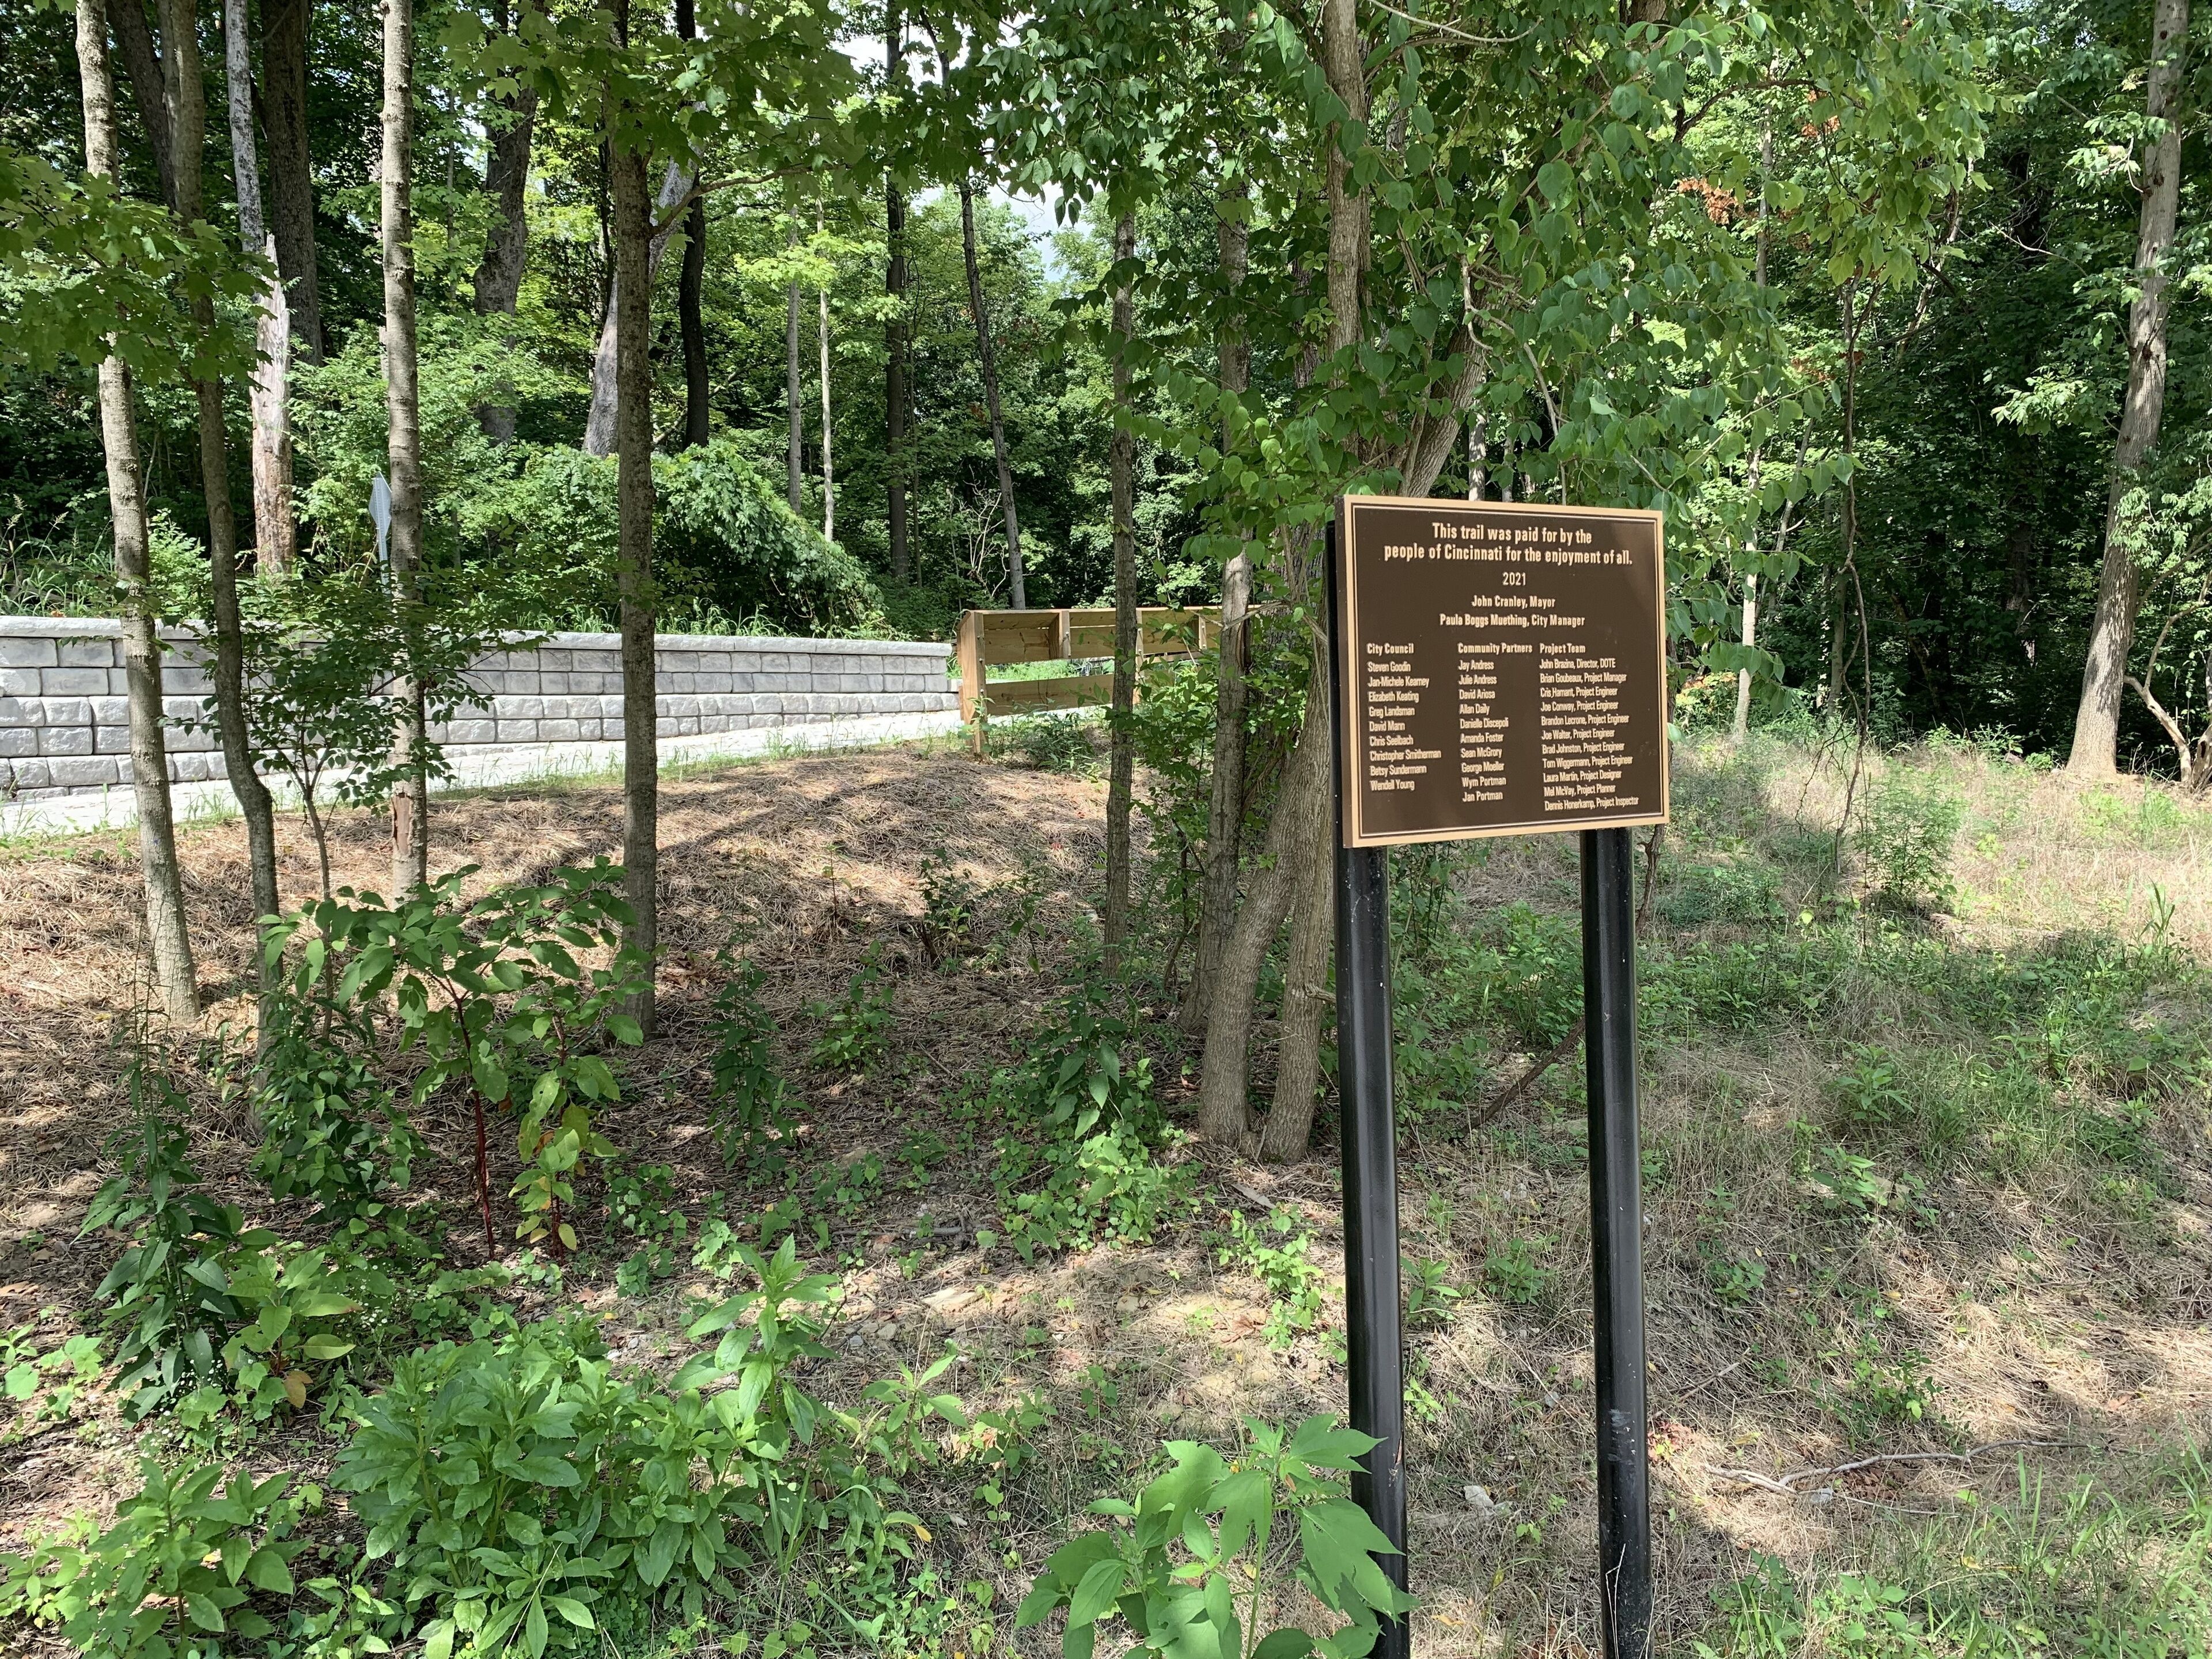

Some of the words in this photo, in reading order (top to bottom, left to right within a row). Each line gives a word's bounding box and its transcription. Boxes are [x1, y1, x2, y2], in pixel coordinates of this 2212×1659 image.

[1433, 522, 1457, 539] This
[1461, 525, 1483, 540] trail
[1488, 528, 1512, 540] was
[1515, 527, 1538, 545] paid
[1541, 528, 1557, 542] for
[1560, 529, 1573, 546] by
[1576, 530, 1592, 543] the
[1384, 543, 1424, 562] people
[1429, 545, 1441, 559] of
[1445, 547, 1502, 561] Cincinnati
[1506, 547, 1521, 562] for
[1525, 548, 1541, 562] the
[1546, 550, 1600, 566] enjoyment
[1604, 551, 1614, 563] of
[1616, 551, 1633, 565] all.
[1503, 573, 1526, 585] 2021
[1471, 596, 1492, 607] John
[1495, 596, 1528, 609] Cranley,
[1530, 597, 1555, 609] Mayor
[1440, 615, 1463, 626] Paula
[1465, 615, 1488, 627] Boggs
[1491, 615, 1529, 628] Muething,
[1532, 615, 1548, 627] City
[1550, 615, 1585, 627] Manager
[1367, 643, 1383, 656] City
[1385, 643, 1414, 654] Council
[1457, 643, 1499, 655] Community
[1502, 643, 1532, 653] Partners
[1540, 643, 1566, 654] Project
[1568, 643, 1585, 653] Team
[1368, 662, 1389, 672] Steven
[1391, 662, 1411, 672] Goodin
[1458, 660, 1469, 672] Jay
[1471, 660, 1494, 669] Andress
[1540, 659, 1553, 668] John
[1555, 658, 1575, 669] Brazina,
[1577, 658, 1599, 669] Director,
[1600, 658, 1615, 668] DOTE
[1368, 677, 1404, 687] Jan-Michele
[1406, 677, 1429, 688] Kearney
[1459, 675, 1472, 685] Julie
[1474, 675, 1497, 684] Andress
[1540, 673, 1554, 683] Brian
[1584, 673, 1603, 684] Project
[1604, 673, 1627, 684] Manager
[1369, 692, 1395, 702] Elizabeth
[1397, 692, 1419, 703] Keating
[1459, 690, 1476, 699] David
[1477, 690, 1495, 698] Ariosa
[1576, 687, 1594, 698] Project
[1596, 687, 1618, 698] Engineer
[1369, 707, 1384, 718] Greg
[1385, 706, 1415, 715] Landsman
[1460, 704, 1474, 714] Allan
[1476, 704, 1490, 715] Daily
[1540, 702, 1551, 711] Joe
[1552, 702, 1576, 712] Conway,
[1577, 702, 1595, 711] Project
[1597, 701, 1619, 712] Engineer
[1460, 719, 1482, 728] Danielle
[1541, 716, 1563, 726] Brandon
[1565, 715, 1586, 726] Lecrone,
[1588, 715, 1607, 726] Project
[1608, 714, 1629, 725] Engineer
[1369, 721, 1386, 731] David
[1388, 721, 1405, 730] Mann
[1370, 736, 1385, 745] Chris
[1387, 735, 1413, 745] Seelbach
[1461, 733, 1484, 743] Amanda
[1486, 733, 1503, 742] Foster
[1541, 730, 1552, 740] Joe
[1553, 730, 1572, 740] Walter,
[1573, 729, 1592, 740] Project
[1593, 729, 1615, 739] Engineer
[1461, 748, 1476, 758] Sean
[1478, 748, 1502, 758] McGrory
[1542, 744, 1555, 754] Brad
[1556, 744, 1582, 753] Johnston,
[1584, 743, 1601, 753] Project
[1603, 743, 1624, 753] Engineer
[1370, 751, 1404, 762] Christopher
[1406, 749, 1441, 759] Smitherman
[1461, 763, 1482, 774] George
[1484, 762, 1504, 772] Moeller
[1543, 759, 1555, 768] Tom
[1556, 758, 1590, 770] Wiggermann,
[1592, 757, 1610, 767] Project
[1611, 756, 1633, 767] Engineer
[1370, 766, 1388, 777] Betsy
[1389, 764, 1426, 774] Sundermann
[1543, 773, 1559, 782] Laura
[1560, 772, 1579, 782] Martin,
[1580, 771, 1599, 781] Project
[1600, 770, 1622, 781] Designer
[1371, 781, 1395, 791] Wendell
[1396, 779, 1415, 790] Young
[1480, 777, 1506, 786] Portman
[1463, 792, 1475, 802] Jan
[1476, 791, 1503, 801] Portman
[1544, 787, 1555, 797] Mel
[1556, 786, 1576, 796] McVay,
[1577, 785, 1596, 796] Project
[1597, 785, 1616, 794] Planner
[1545, 801, 1563, 811] Dennis
[1565, 800, 1596, 812] Honerkamp,
[1597, 799, 1615, 809] Project
[1616, 797, 1639, 808] Inspector
